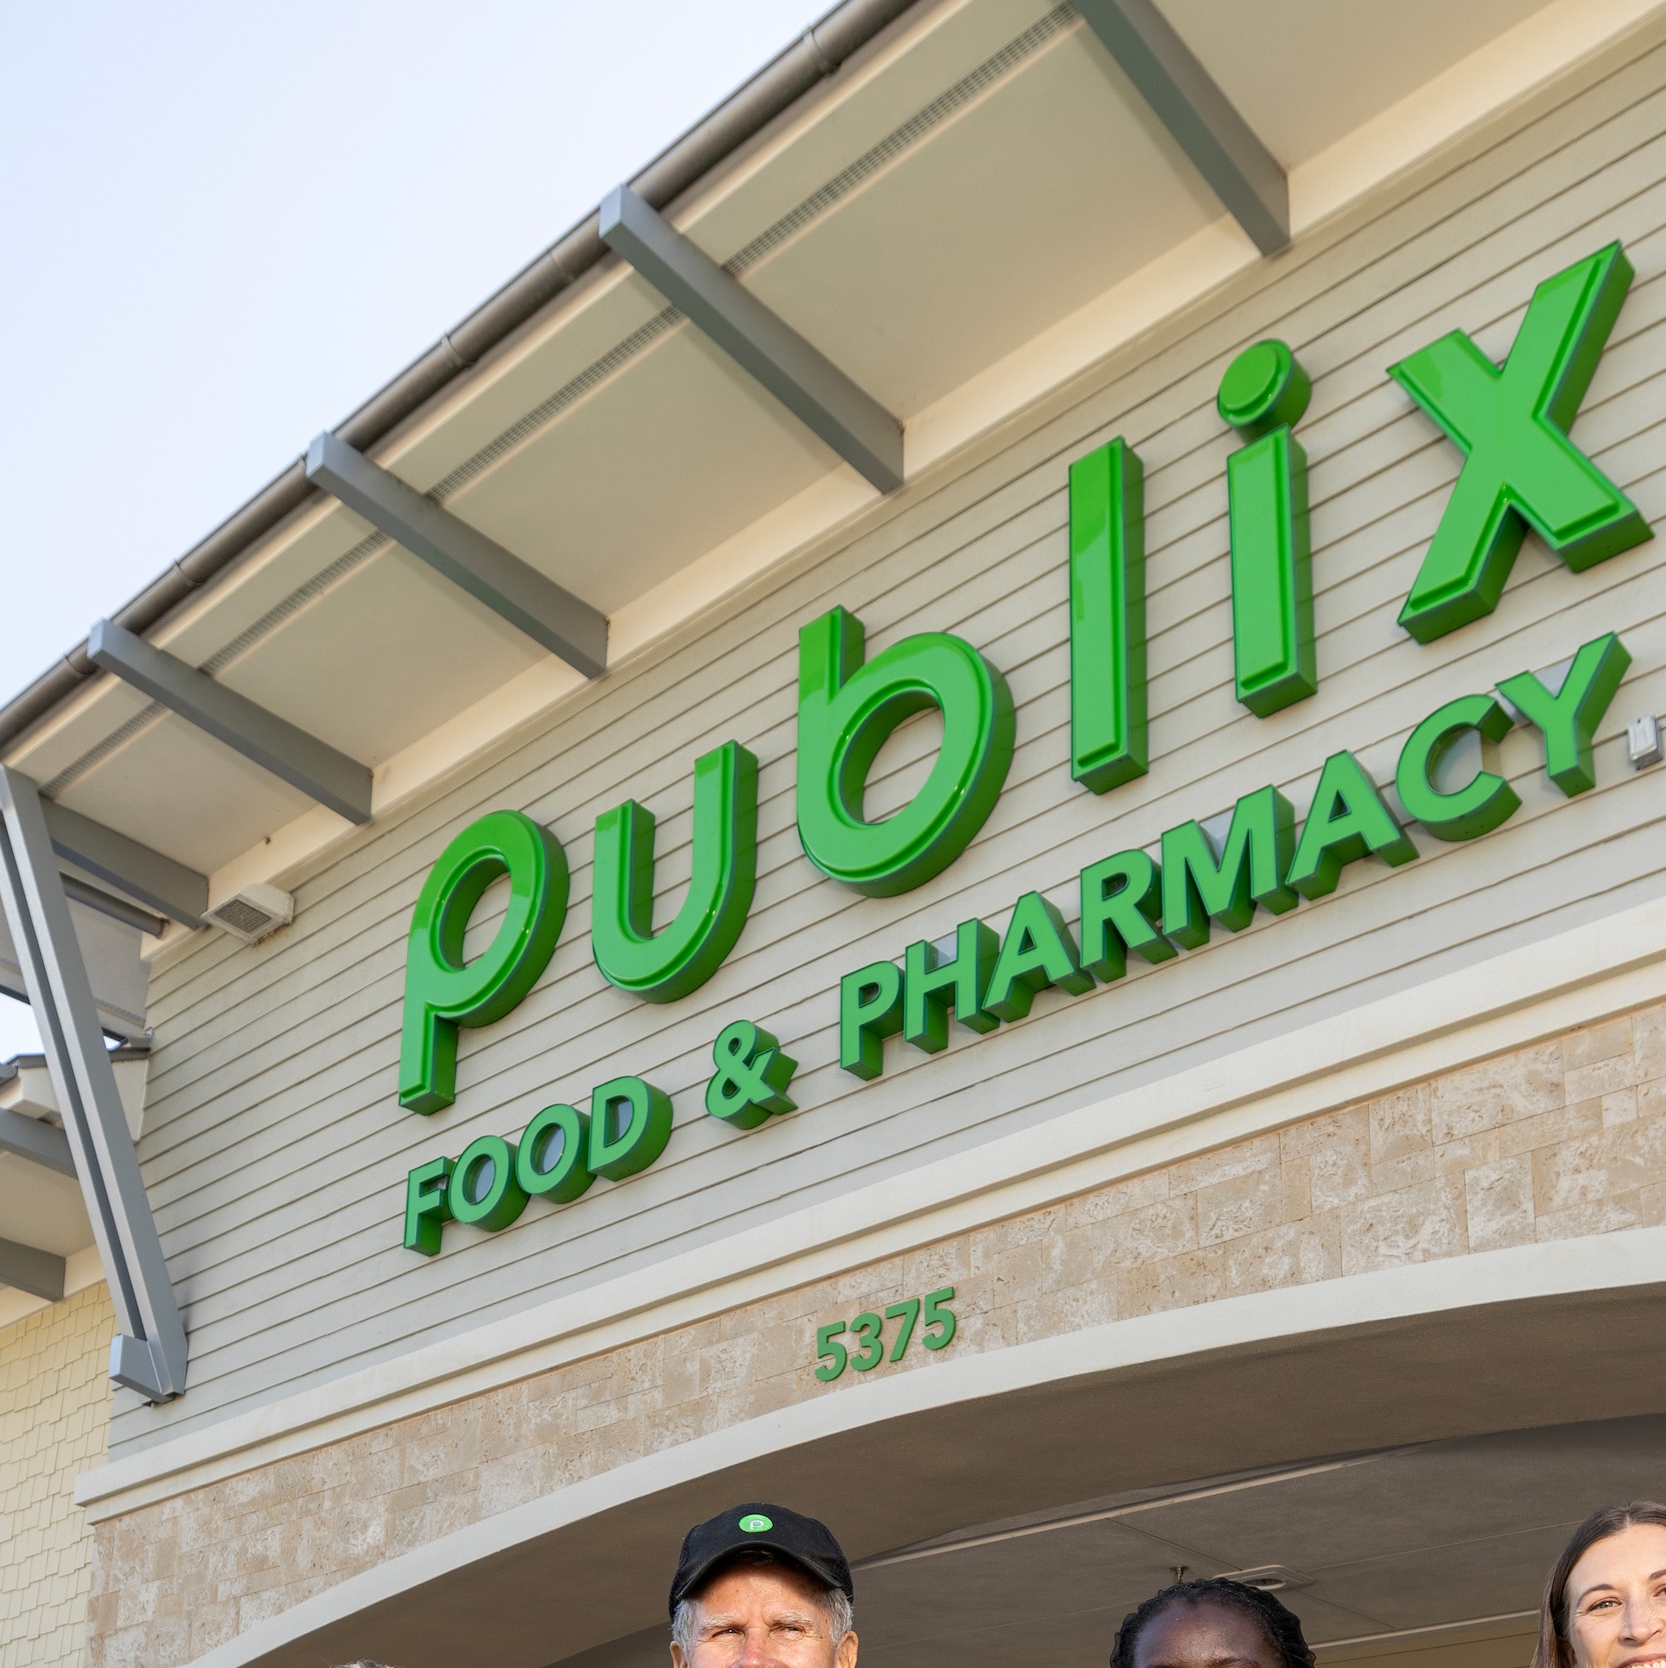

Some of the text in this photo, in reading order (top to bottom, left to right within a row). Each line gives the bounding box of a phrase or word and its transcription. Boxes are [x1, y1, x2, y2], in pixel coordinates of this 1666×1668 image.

[403, 631, 1633, 1257] FOOD & PHARMACY
[814, 1286, 957, 1382] 5375
